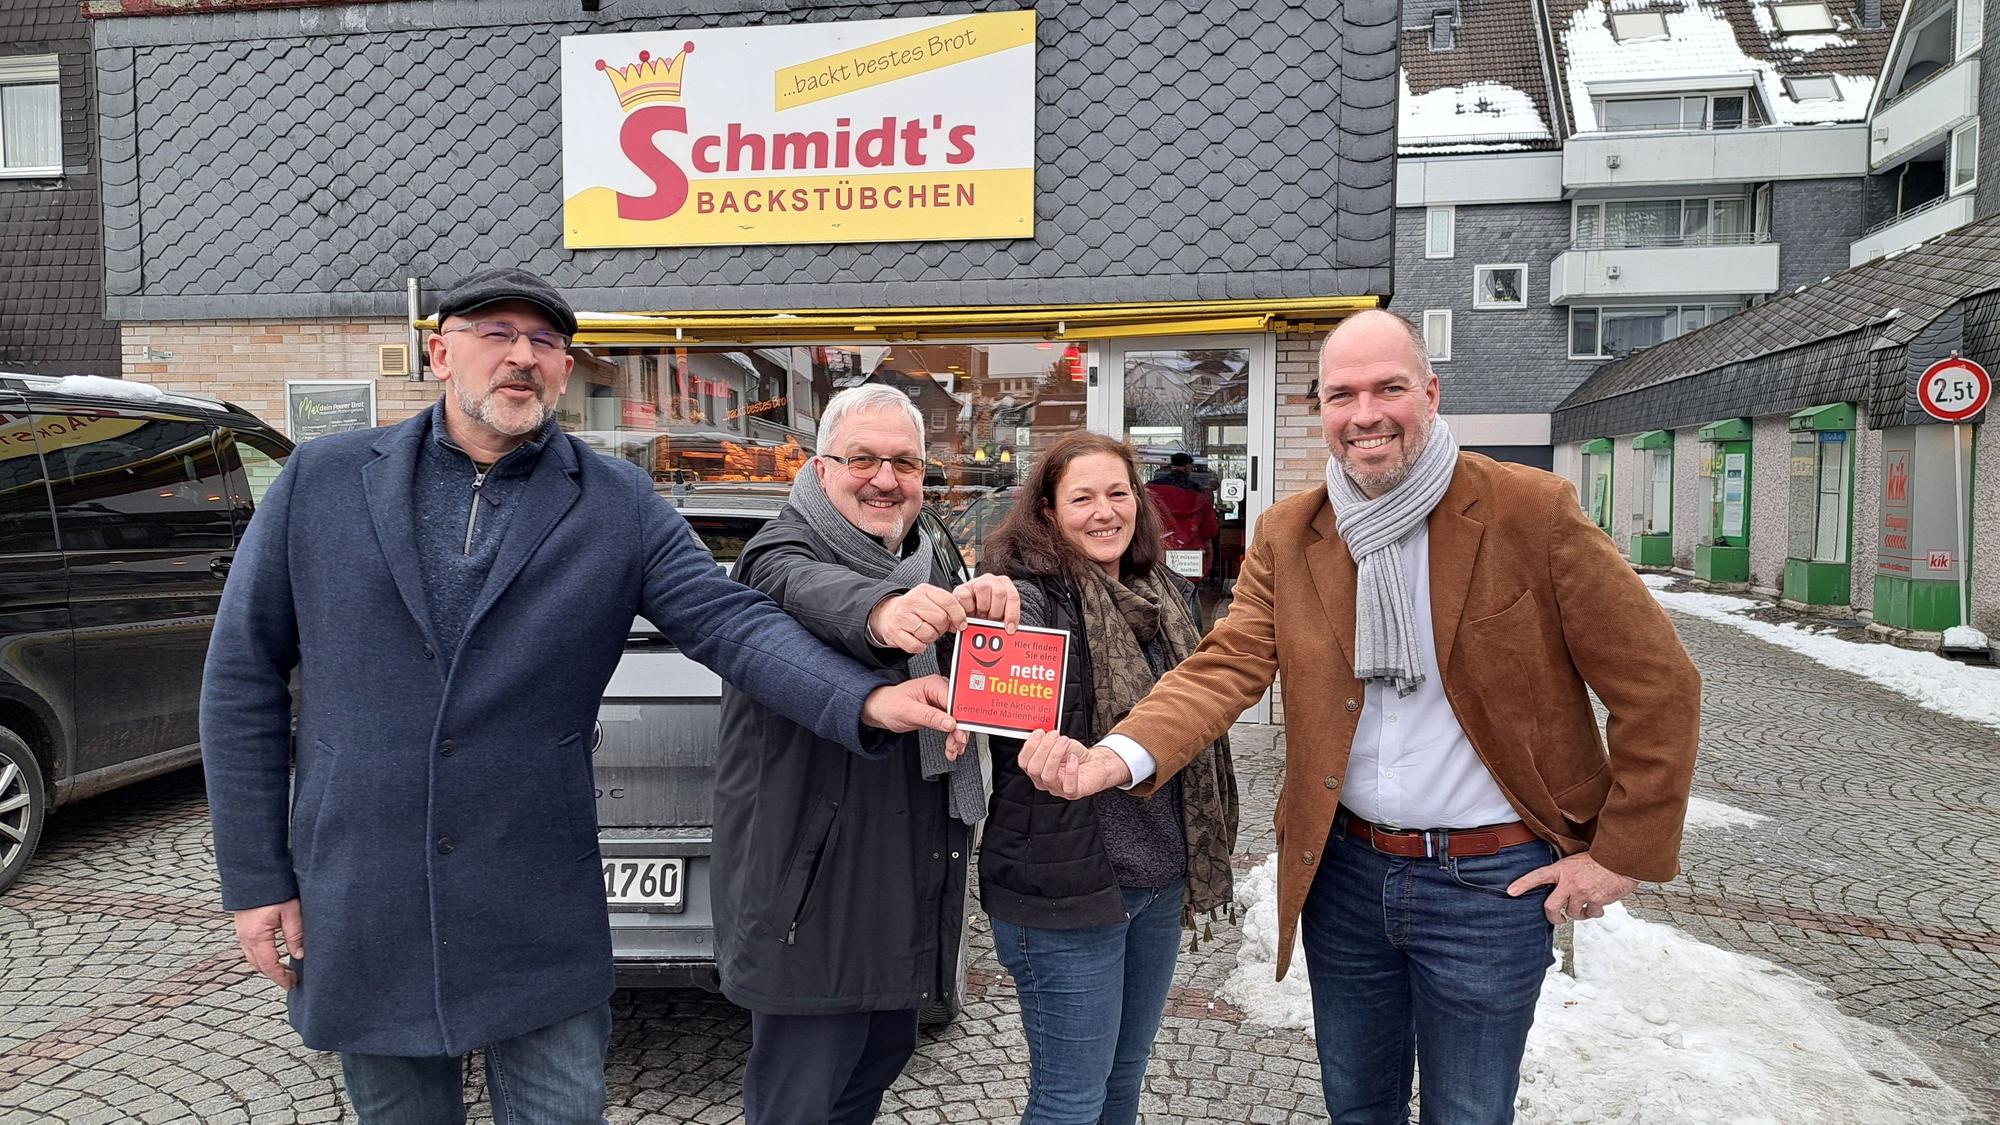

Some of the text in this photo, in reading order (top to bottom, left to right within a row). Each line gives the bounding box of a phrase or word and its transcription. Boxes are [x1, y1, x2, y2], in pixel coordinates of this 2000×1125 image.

[783, 27, 977, 98] ...backt bestes Brot
[616, 105, 976, 221] Schmidt's
[697, 181, 976, 214] BACKSTÜBCHEN
[1014, 640, 1058, 652] Hier finden
[1025, 651, 1057, 662] Sie eine
[1010, 664, 1056, 681] nette
[988, 676, 1054, 700] Toilette
[957, 704, 1051, 723] Gemeinde Marienheide
[991, 699, 1052, 713] Eine Aktion der
[603, 864, 677, 898] 1760
